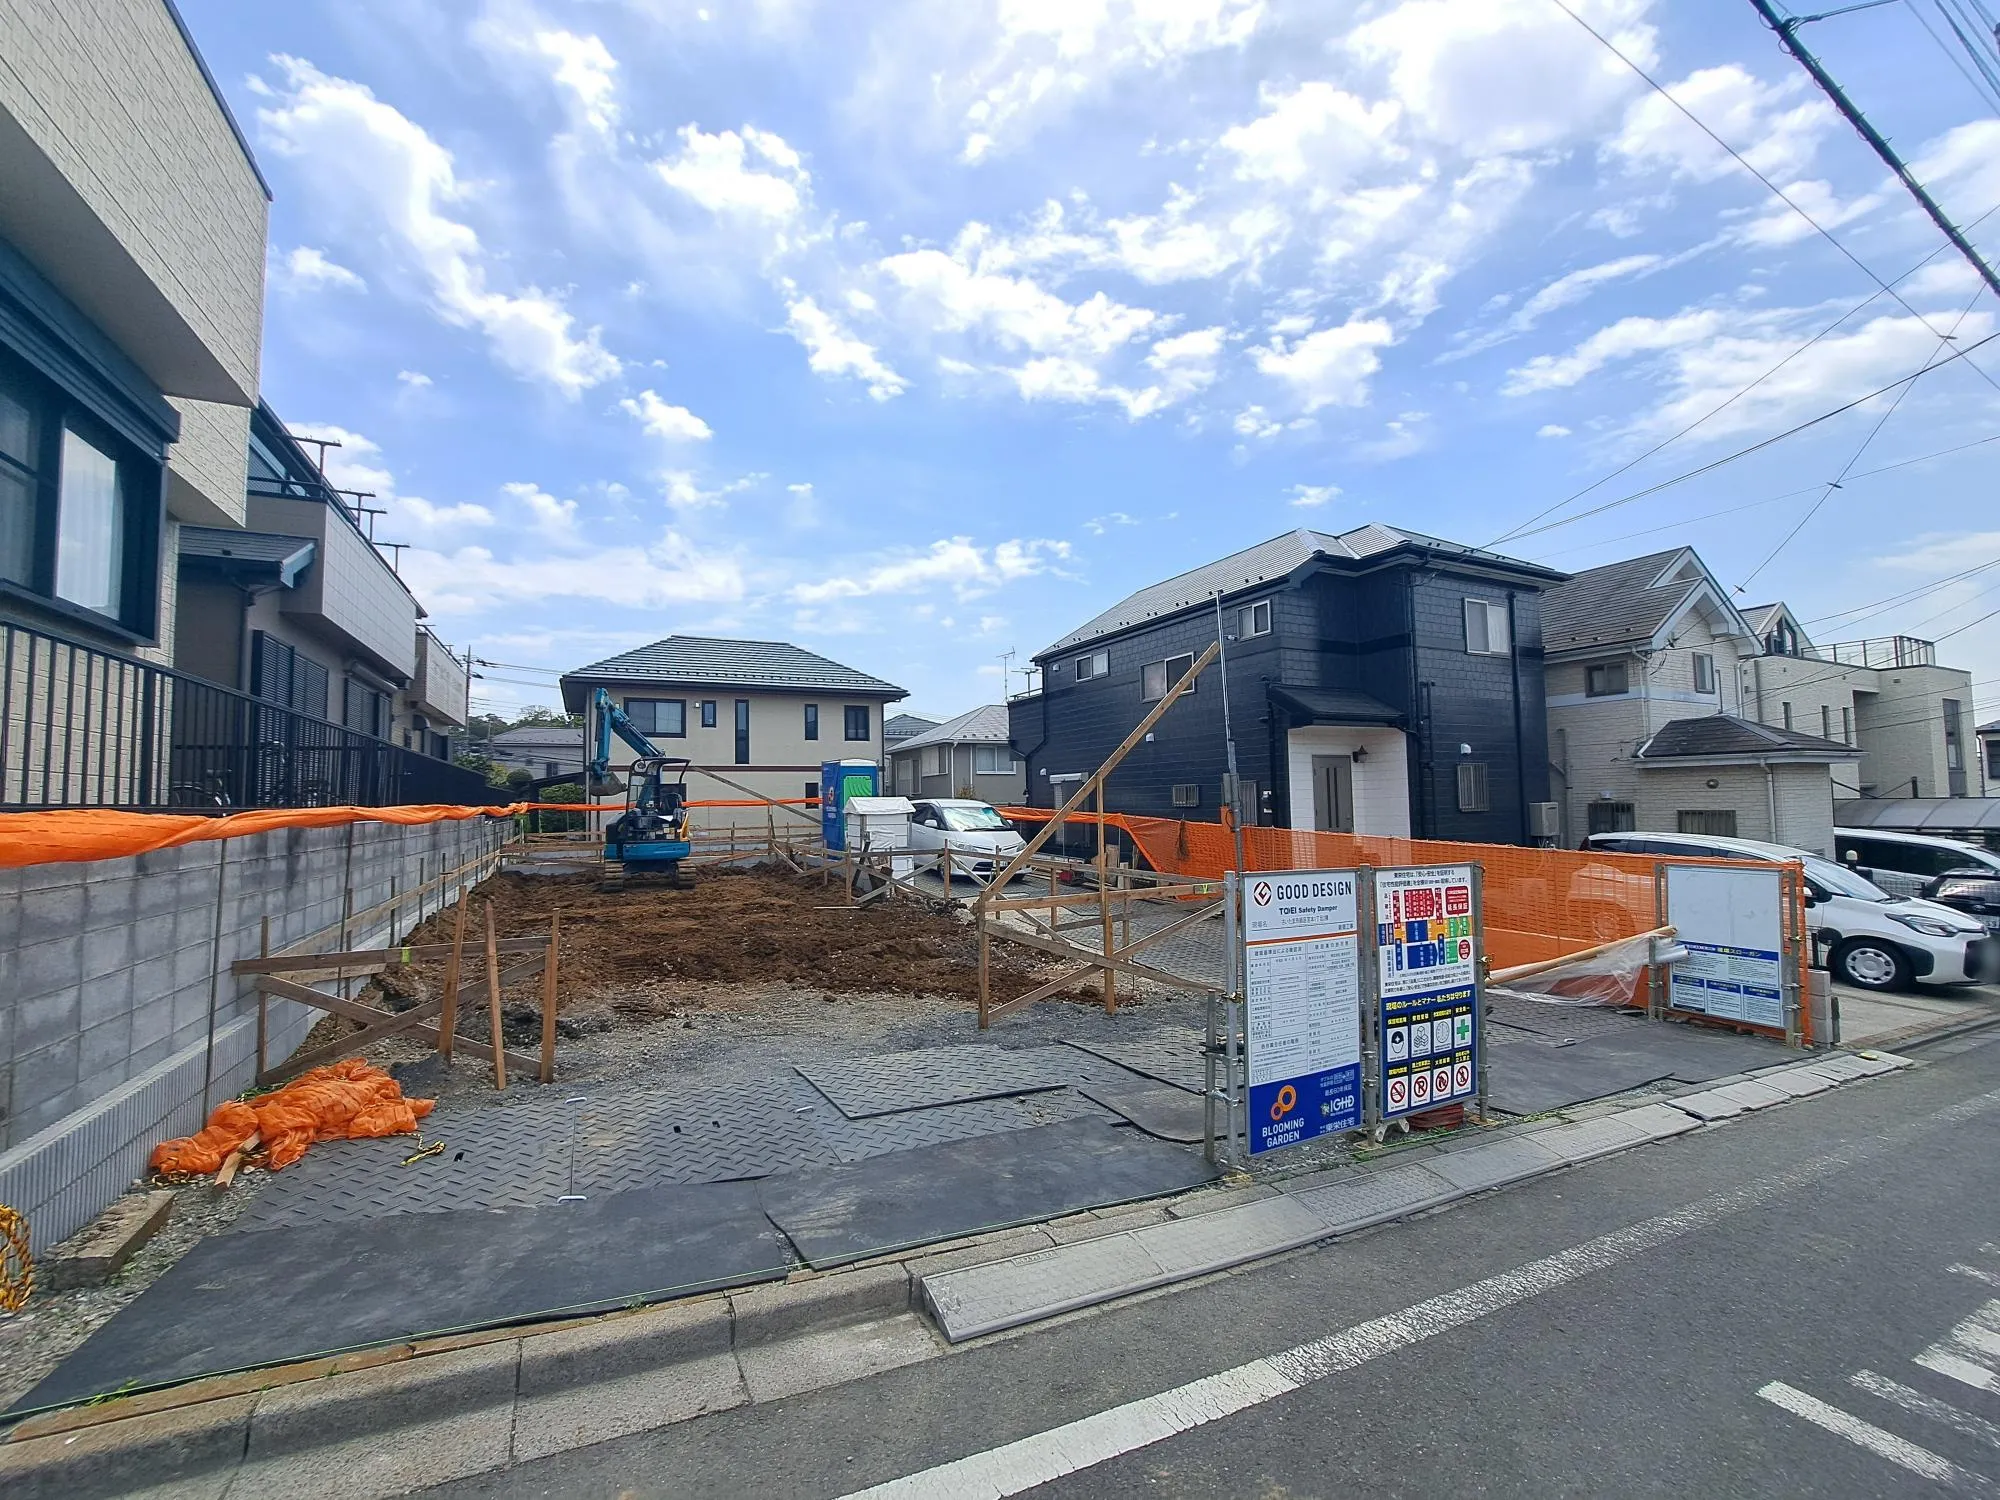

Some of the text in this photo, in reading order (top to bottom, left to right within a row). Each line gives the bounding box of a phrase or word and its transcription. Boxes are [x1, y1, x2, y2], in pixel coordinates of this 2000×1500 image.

[1277, 881, 1352, 900] GOOD DESIGN
[1298, 906, 1316, 915] Safety
[1317, 904, 1338, 914] Damper
[1385, 998, 1436, 1011] 現場のルールとマナー
[1262, 1117, 1305, 1138] BLOOMING
[1325, 1116, 1355, 1132] 東栄住宅
[1266, 1130, 1300, 1148] GARDEN
